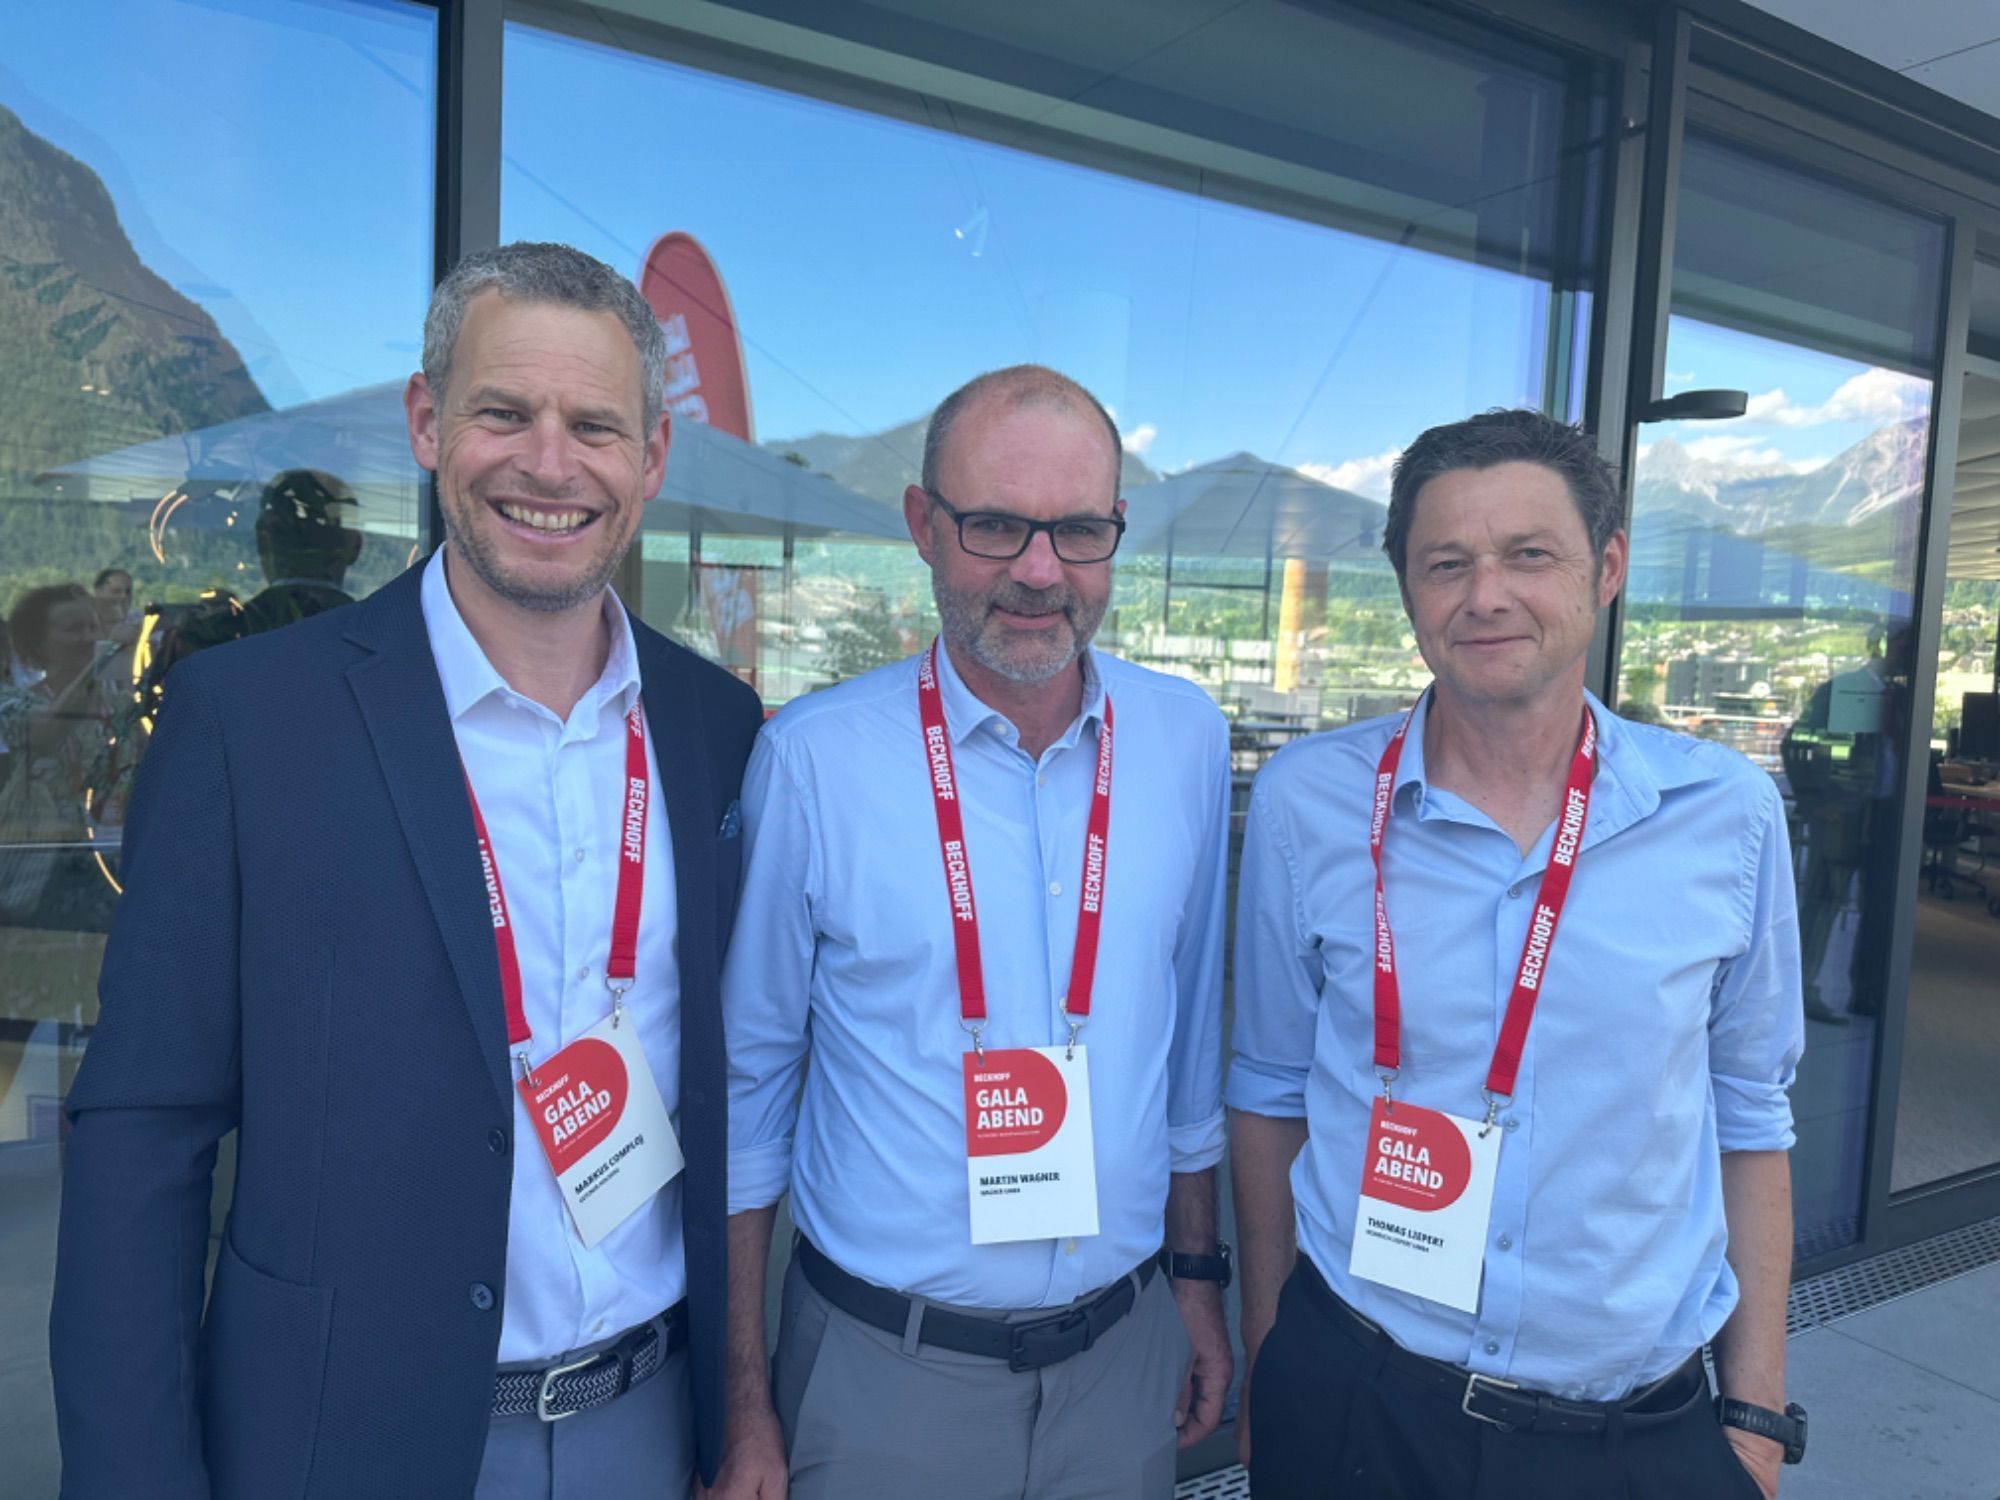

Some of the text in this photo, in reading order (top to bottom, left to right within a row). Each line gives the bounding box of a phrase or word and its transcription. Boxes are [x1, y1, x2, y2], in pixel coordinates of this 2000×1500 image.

[926, 725, 954, 801] BECKHOFF
[1096, 723, 1112, 796] BECKHOFF
[625, 777, 646, 864] BECKHOFF
[1370, 772, 1392, 845] BECKHOFF
[1553, 787, 1587, 867] BECKHOFF
[944, 840, 973, 921] BECKHOFF
[1083, 833, 1104, 912] BECKHOFF
[1519, 904, 1555, 990] BECKHOFF
[544, 1080, 594, 1125] GALA
[552, 1089, 612, 1146] ABEND
[976, 1087, 1029, 1108] GALA
[977, 1107, 1044, 1130] ABEND
[574, 1159, 610, 1195] MARKUS
[1374, 1156, 1444, 1189] ABEND
[1378, 1136, 1430, 1165] GALA
[980, 1172, 1060, 1187] MARTIN WAGNER
[1367, 1216, 1406, 1237] THOMAS
